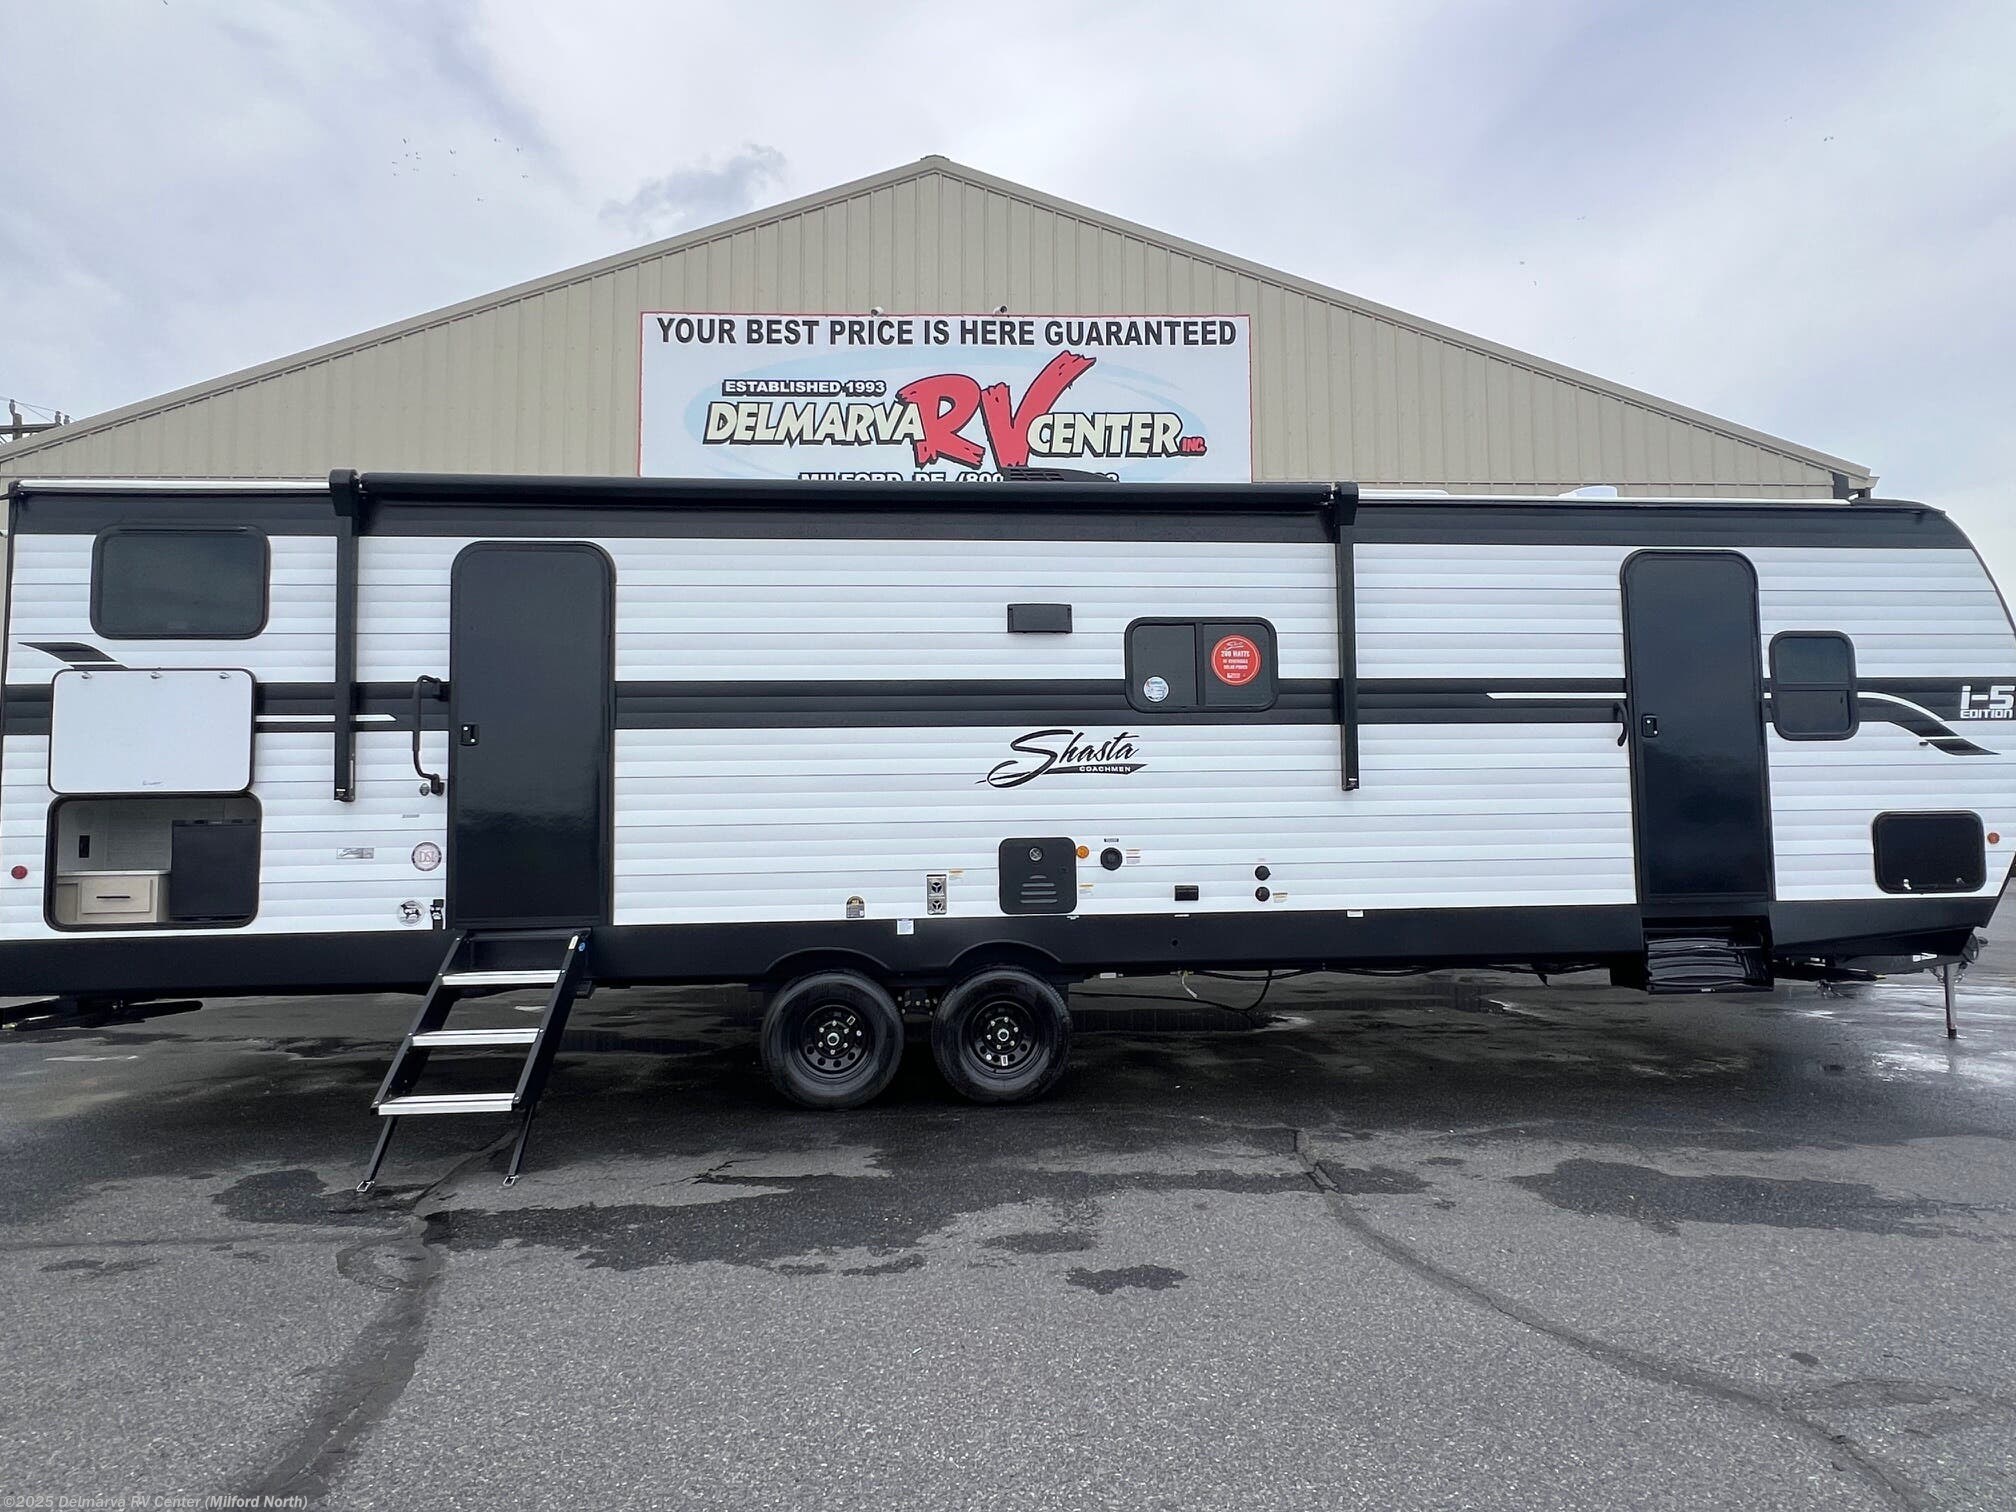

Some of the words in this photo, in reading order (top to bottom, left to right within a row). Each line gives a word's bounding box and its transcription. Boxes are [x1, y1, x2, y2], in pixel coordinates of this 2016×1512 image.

[656, 317, 737, 344] YOUR
[746, 319, 820, 345] BEST
[829, 320, 914, 345] PRICE
[924, 320, 950, 345] IS
[960, 320, 1035, 346] HERE
[1044, 320, 1237, 346] GUARANTEED
[724, 380, 842, 395] ESTABLISHED
[845, 381, 886, 395] 1993
[703, 401, 927, 447] DELMARVA
[896, 350, 1096, 470] RV
[1027, 412, 1183, 457] CENTER
[1960, 709, 2014, 719] EDITION
[986, 729, 1140, 788] Shasta
